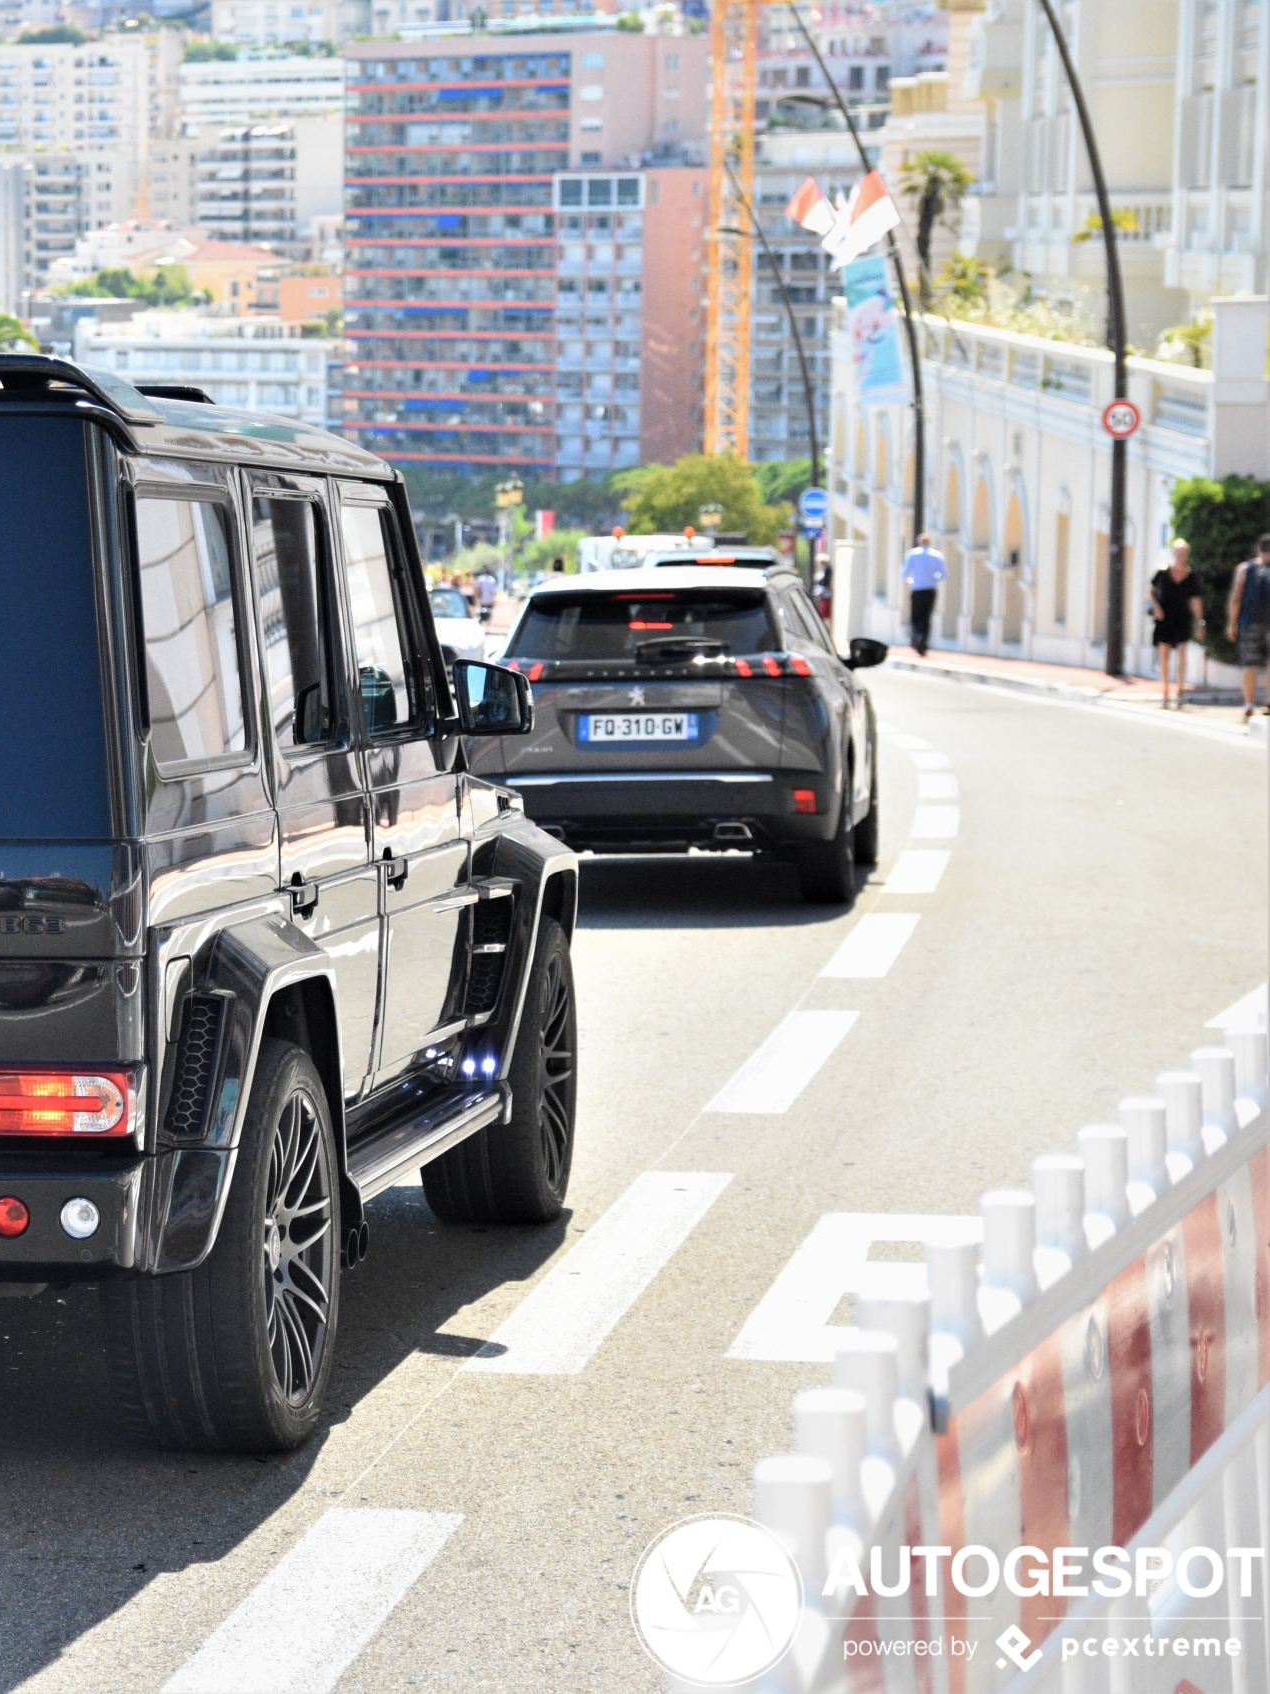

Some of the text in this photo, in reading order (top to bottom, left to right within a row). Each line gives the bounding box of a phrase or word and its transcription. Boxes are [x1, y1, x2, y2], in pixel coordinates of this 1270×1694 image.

[1111, 410, 1135, 428] 50
[593, 718, 684, 736] FQ-310-GW
[0, 915, 66, 935] B63
